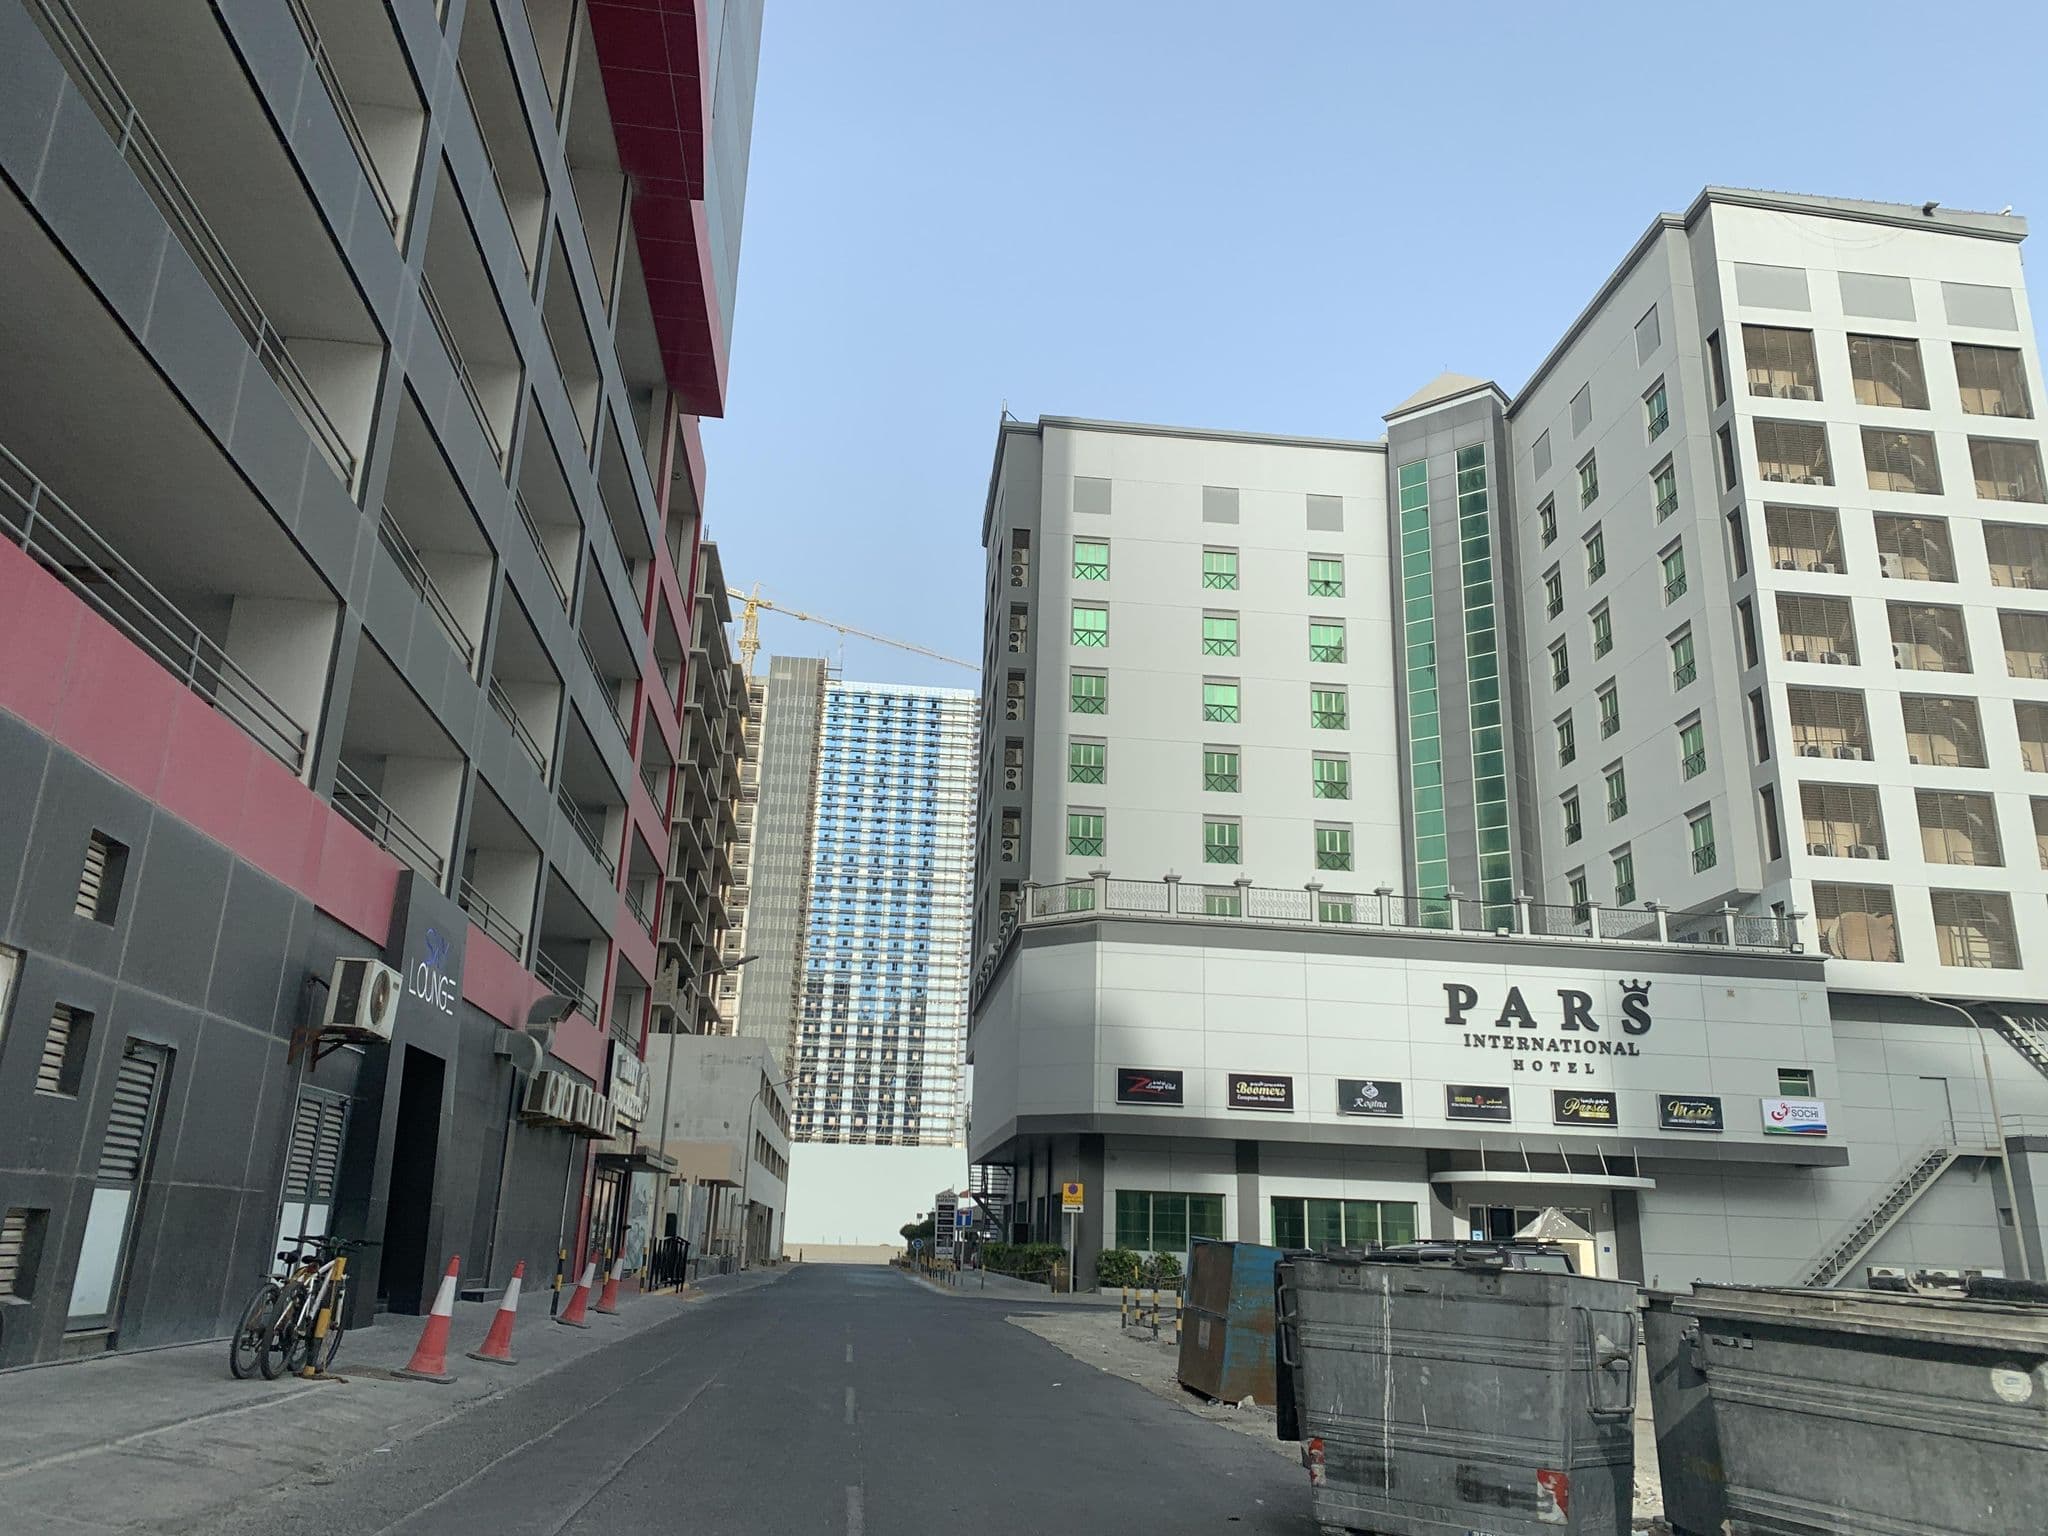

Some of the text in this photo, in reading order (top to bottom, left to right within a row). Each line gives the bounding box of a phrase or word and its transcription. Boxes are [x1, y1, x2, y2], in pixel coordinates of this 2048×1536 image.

[408, 958, 457, 1017] LOUNGE
[1442, 983, 1652, 1036] PARS
[1463, 1033, 1641, 1056] INTERNATIONAL
[1513, 1059, 1595, 1075] HOTEL
[1236, 1081, 1286, 1097] Boomers
[1562, 1097, 1609, 1116] Parsia
[1791, 1109, 1819, 1118] SOCHI
